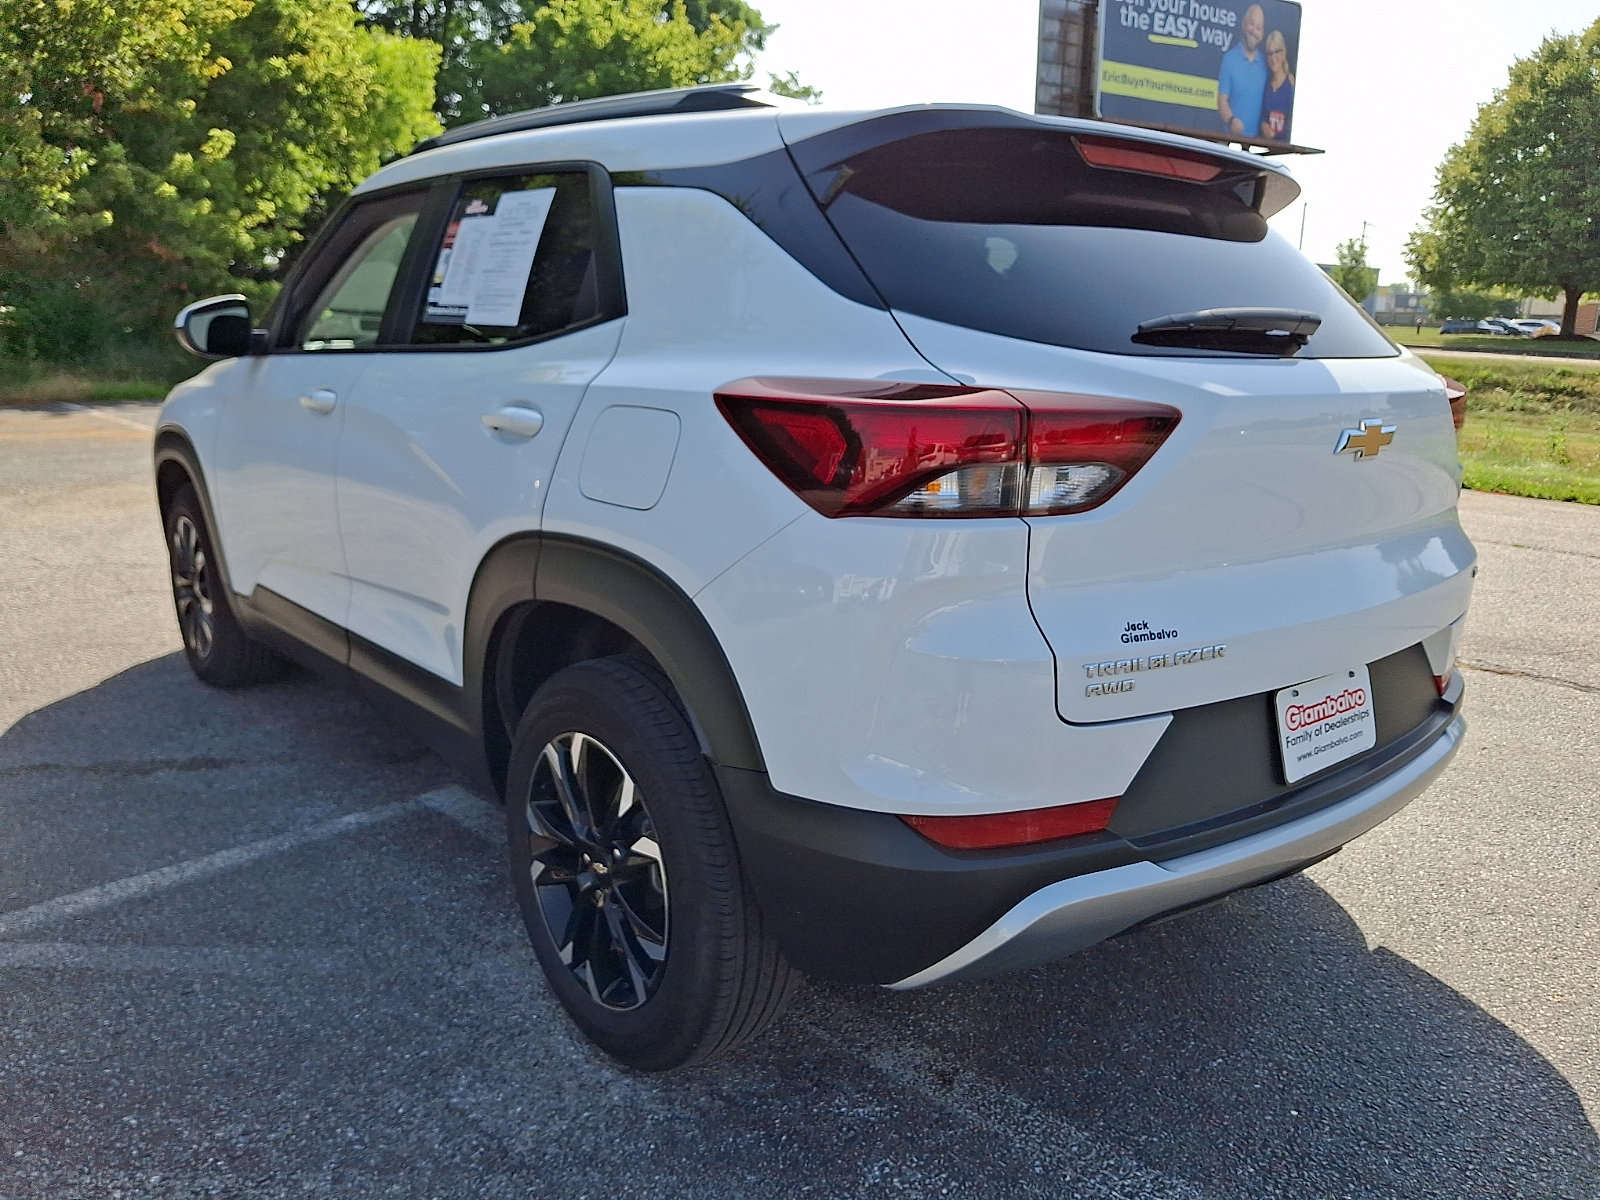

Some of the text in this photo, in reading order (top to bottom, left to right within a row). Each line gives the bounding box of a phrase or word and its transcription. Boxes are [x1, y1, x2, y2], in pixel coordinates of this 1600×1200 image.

[1120, 5, 1233, 52] the EASY way
[1147, 0, 1237, 27] your house
[1103, 70, 1215, 99] EricBuysYourHouse.com
[1120, 628, 1179, 644] Giambalvo
[1124, 620, 1150, 632] Jack
[1083, 644, 1228, 678] TRAILBLAZER
[1085, 678, 1136, 698] AWD
[1285, 688, 1366, 732] Giambalvo
[1286, 709, 1370, 749] Family of Dealerships
[1297, 730, 1364, 763] www.Giambalvo.com
